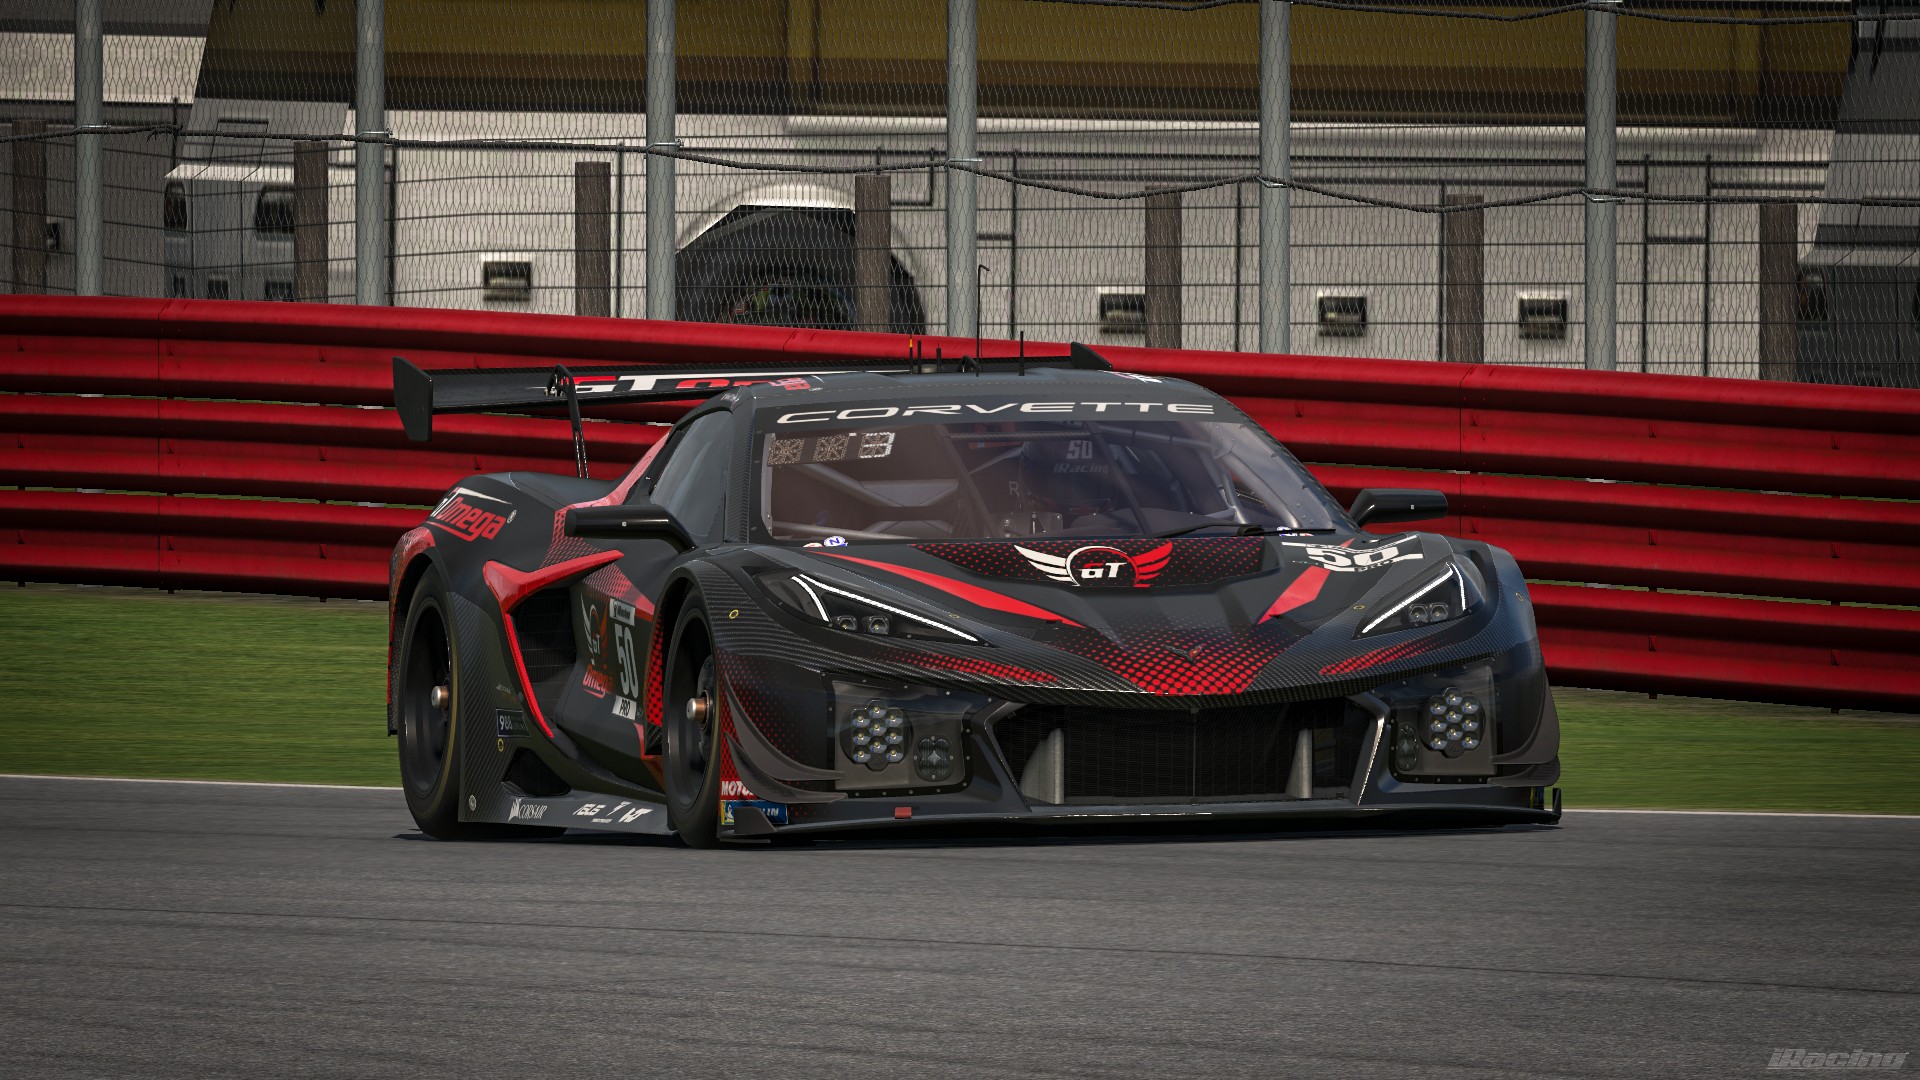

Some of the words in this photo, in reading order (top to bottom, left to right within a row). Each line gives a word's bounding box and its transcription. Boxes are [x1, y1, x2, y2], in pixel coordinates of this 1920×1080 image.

[777, 401, 1215, 425] CORVETTE
[1066, 439, 1093, 460] 50
[1052, 462, 1109, 475] iRacing
[1305, 546, 1400, 568] 50
[1075, 562, 1128, 580] GT
[614, 622, 640, 700] 50
[618, 698, 631, 717] PRO
[721, 780, 757, 797] MOTU
[518, 804, 548, 820] CORSAIR
